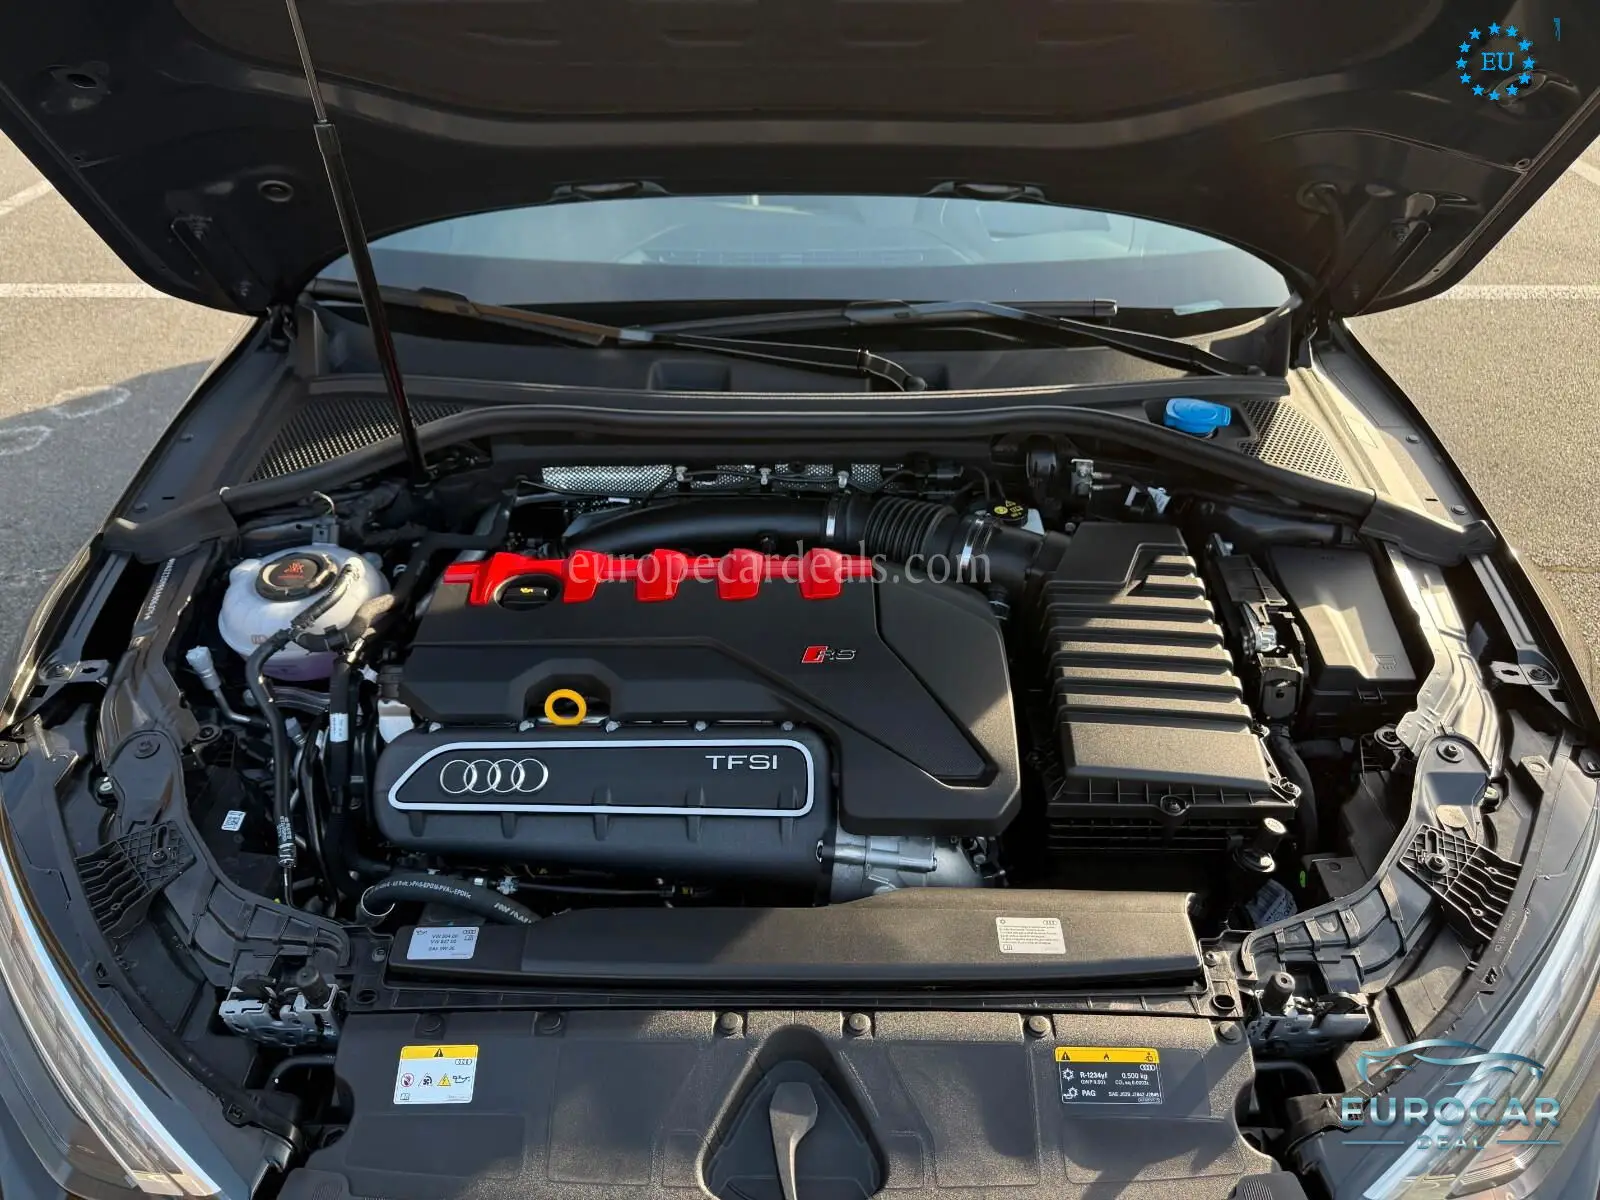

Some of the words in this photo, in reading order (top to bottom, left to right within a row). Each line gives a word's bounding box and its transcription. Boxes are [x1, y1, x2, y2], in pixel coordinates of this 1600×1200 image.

[808, 647, 856, 662] RS
[705, 754, 778, 770] TFSI
[1079, 1071, 1108, 1080] R-1234yf
